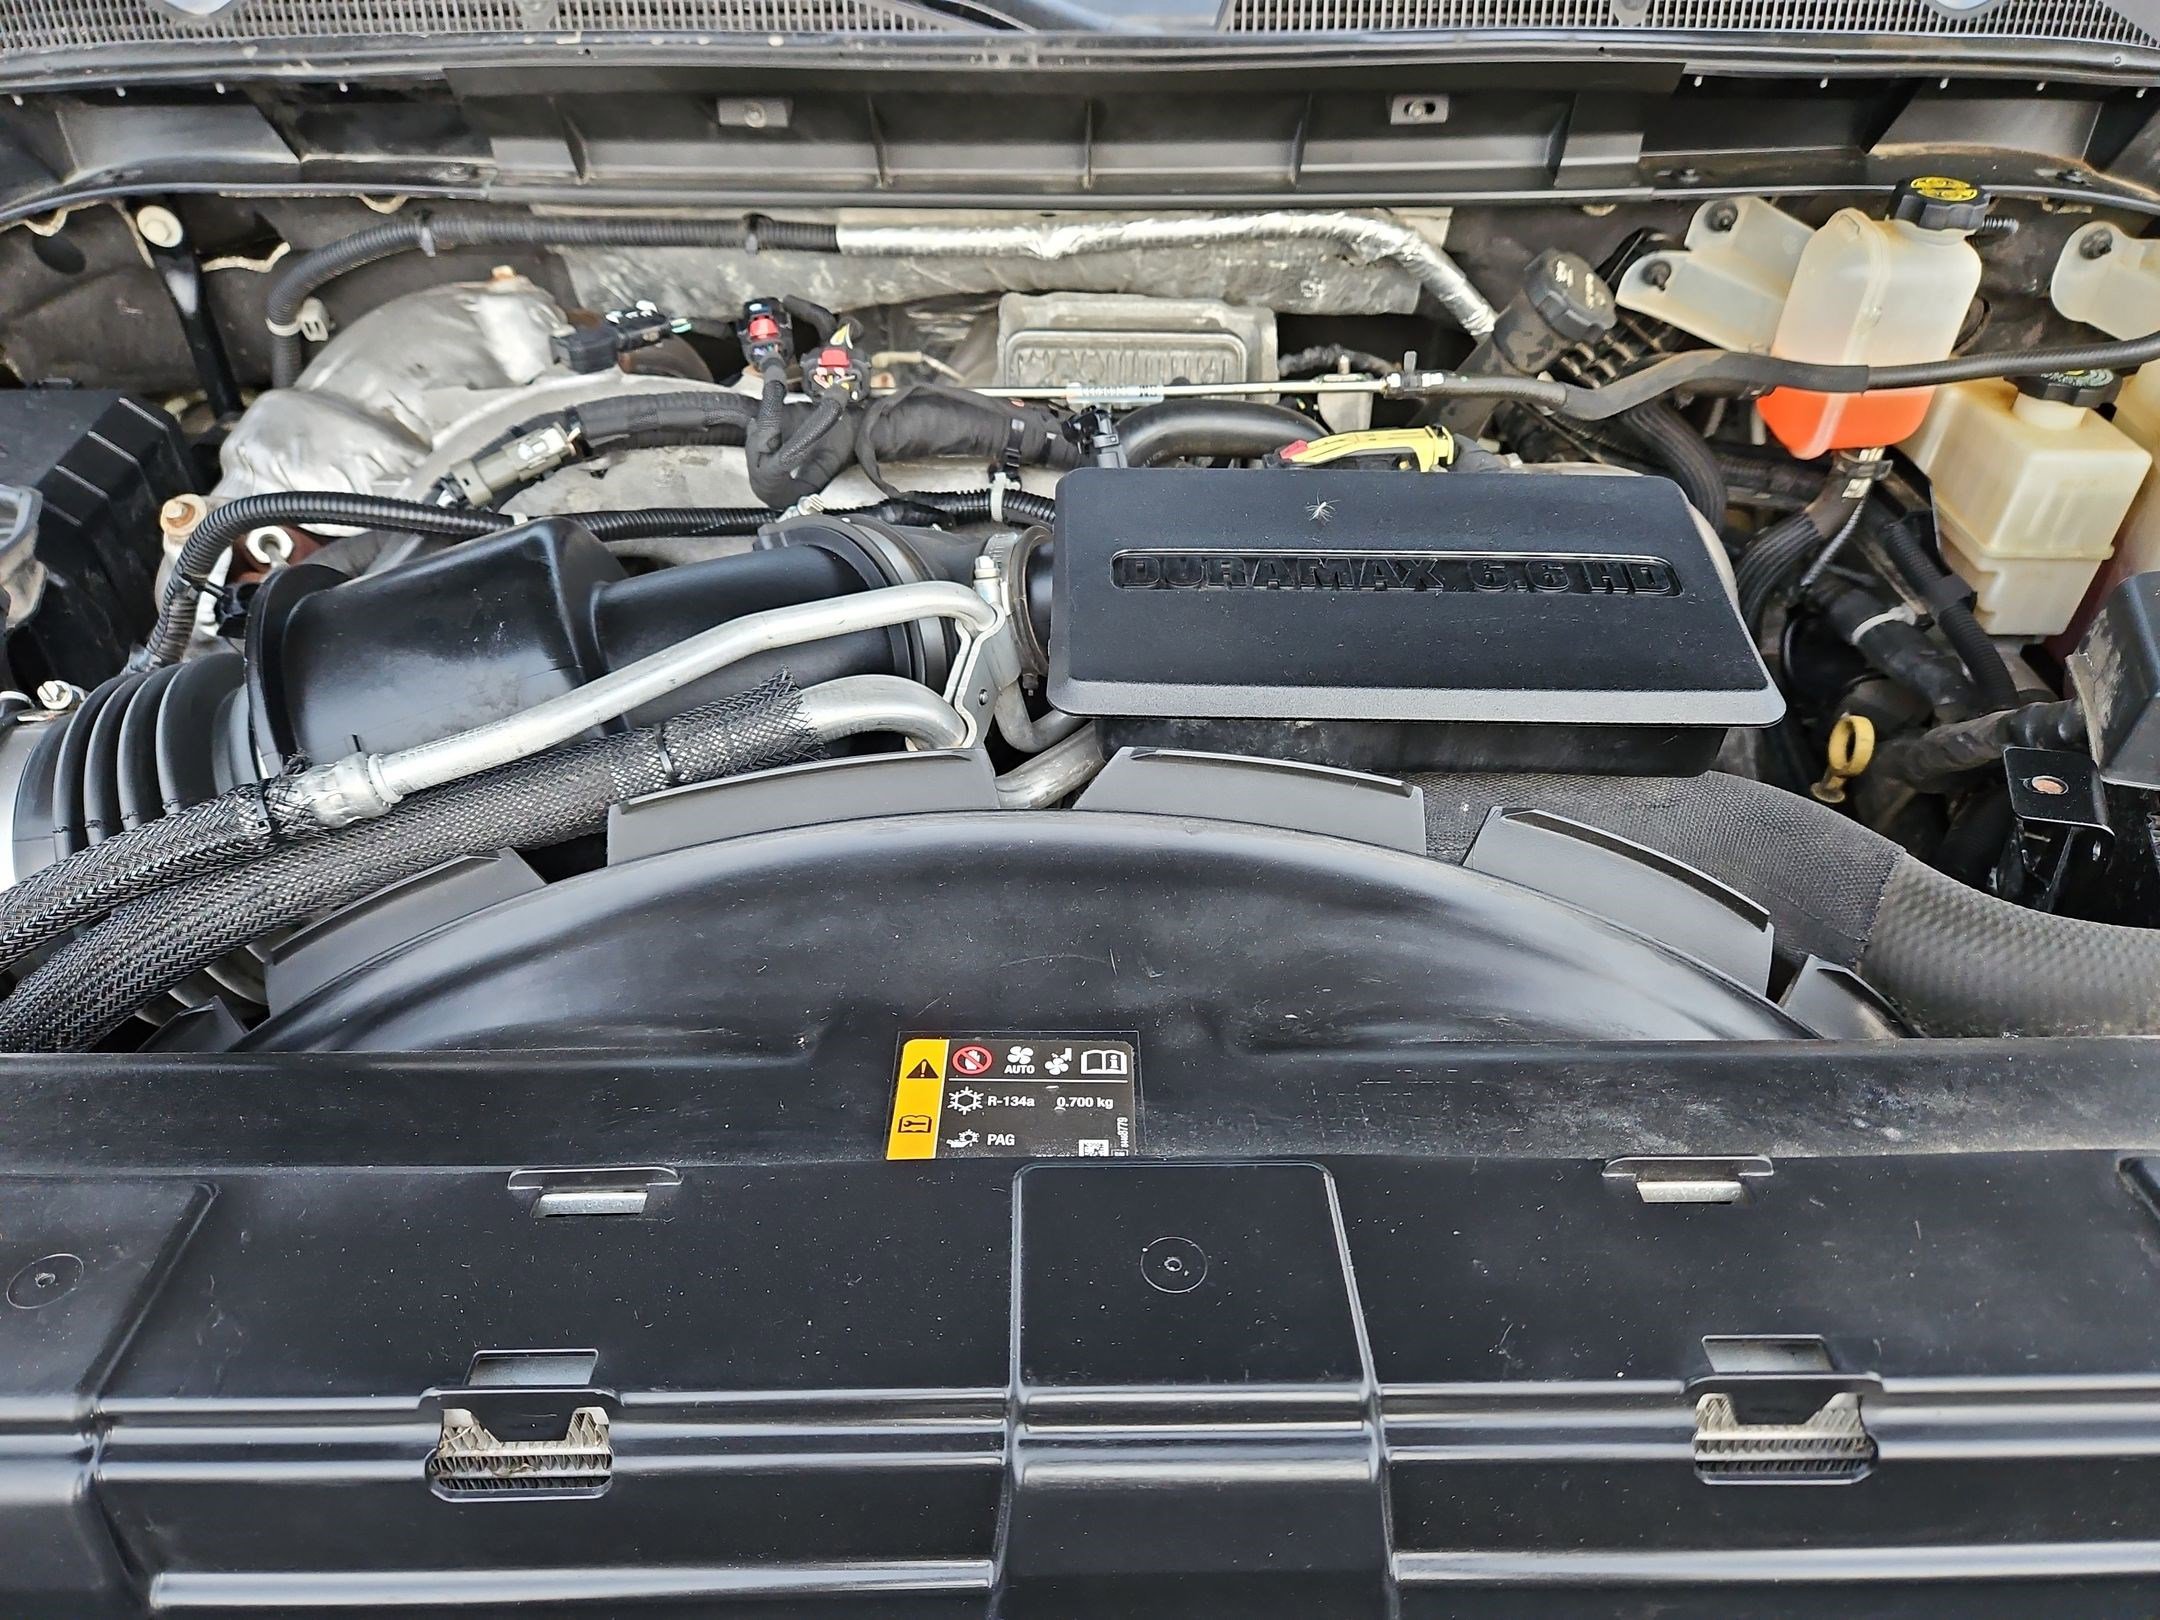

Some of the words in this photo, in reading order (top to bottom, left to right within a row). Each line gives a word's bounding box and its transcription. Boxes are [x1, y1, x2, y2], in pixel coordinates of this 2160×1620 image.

[1119, 556, 1444, 591] DURAMAX
[1469, 559, 1570, 592] 6.6
[1582, 560, 1672, 595] HD
[1004, 1064, 1036, 1075] AUTO
[987, 1095, 1036, 1108] R-134a
[1056, 1096, 1094, 1108] 0.700
[1096, 1096, 1114, 1110] kg
[986, 1133, 1016, 1147] PAG
